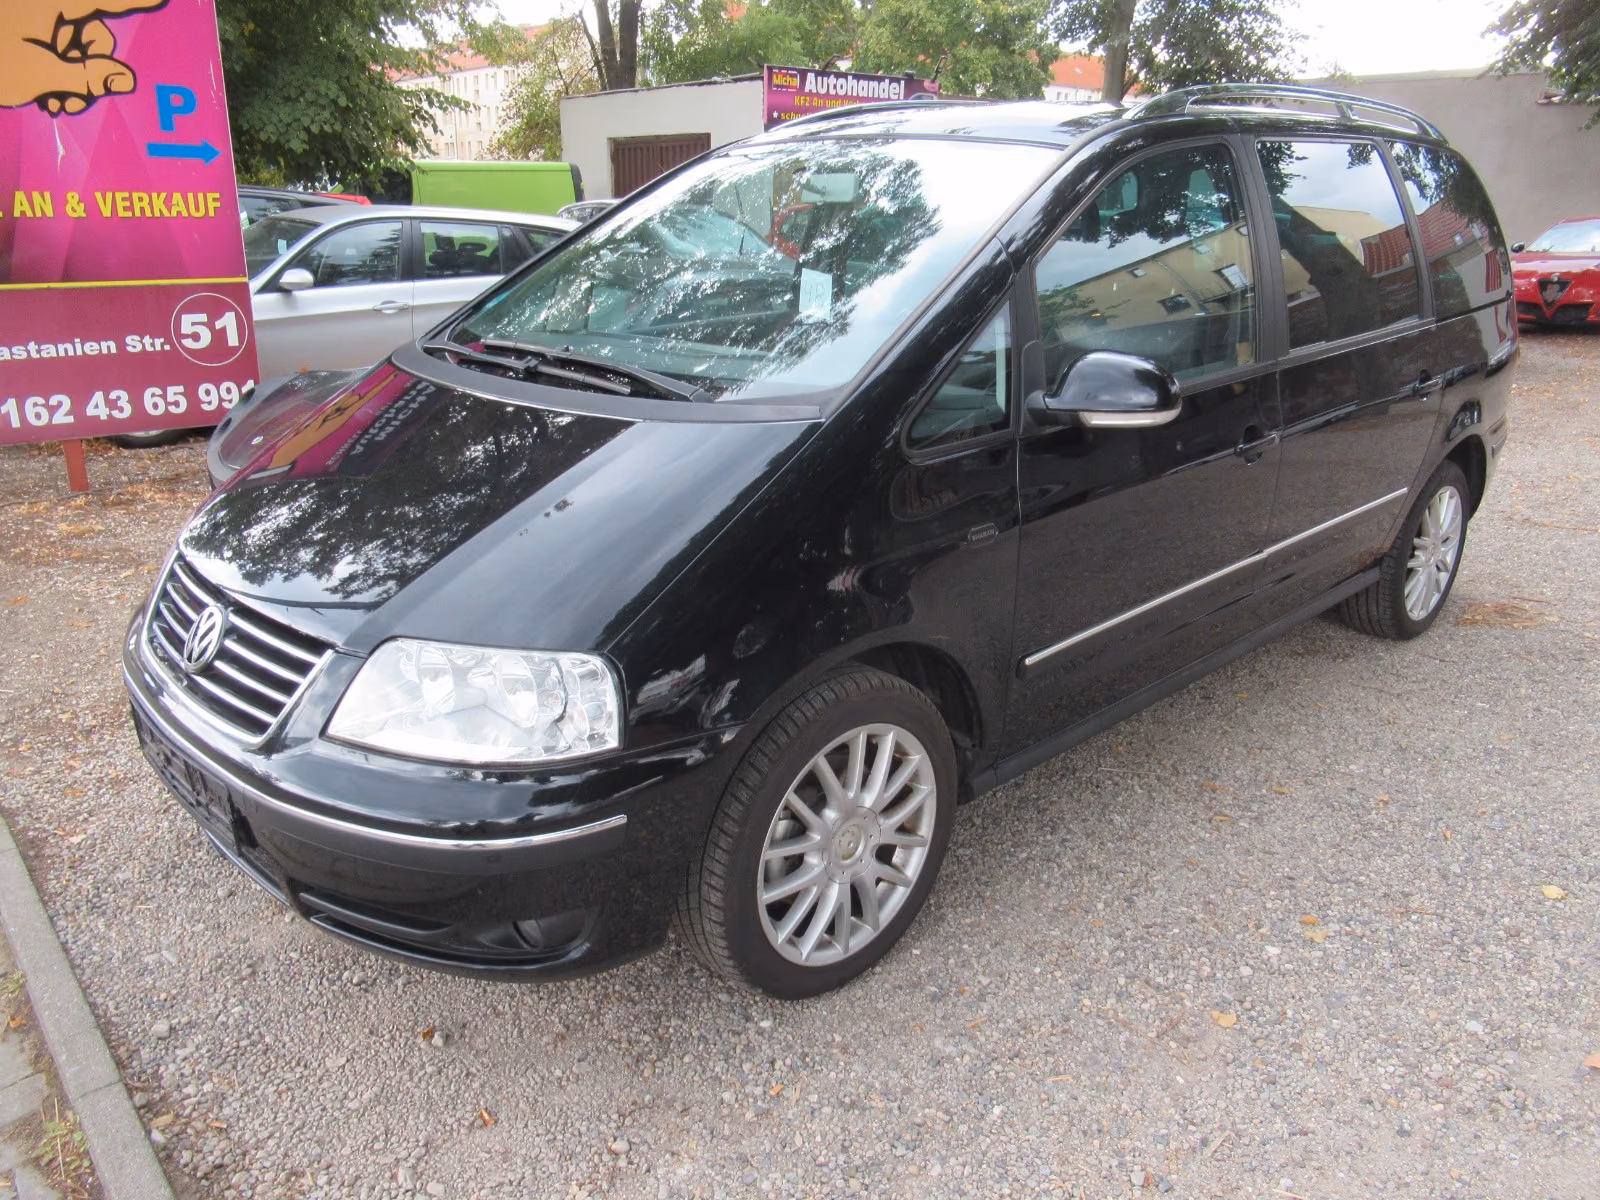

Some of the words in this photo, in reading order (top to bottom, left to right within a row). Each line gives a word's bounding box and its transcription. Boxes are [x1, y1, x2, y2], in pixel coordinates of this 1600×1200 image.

[772, 72, 799, 87] Micha
[804, 72, 905, 100] Autohandel
[155, 84, 198, 132] P
[13, 191, 54, 218] AN
[65, 191, 87, 218] &
[94, 191, 221, 218] VERKAUF
[125, 334, 171, 353] Str.
[180, 311, 239, 350] 51
[86, 390, 132, 421] 43
[143, 385, 188, 416] 65
